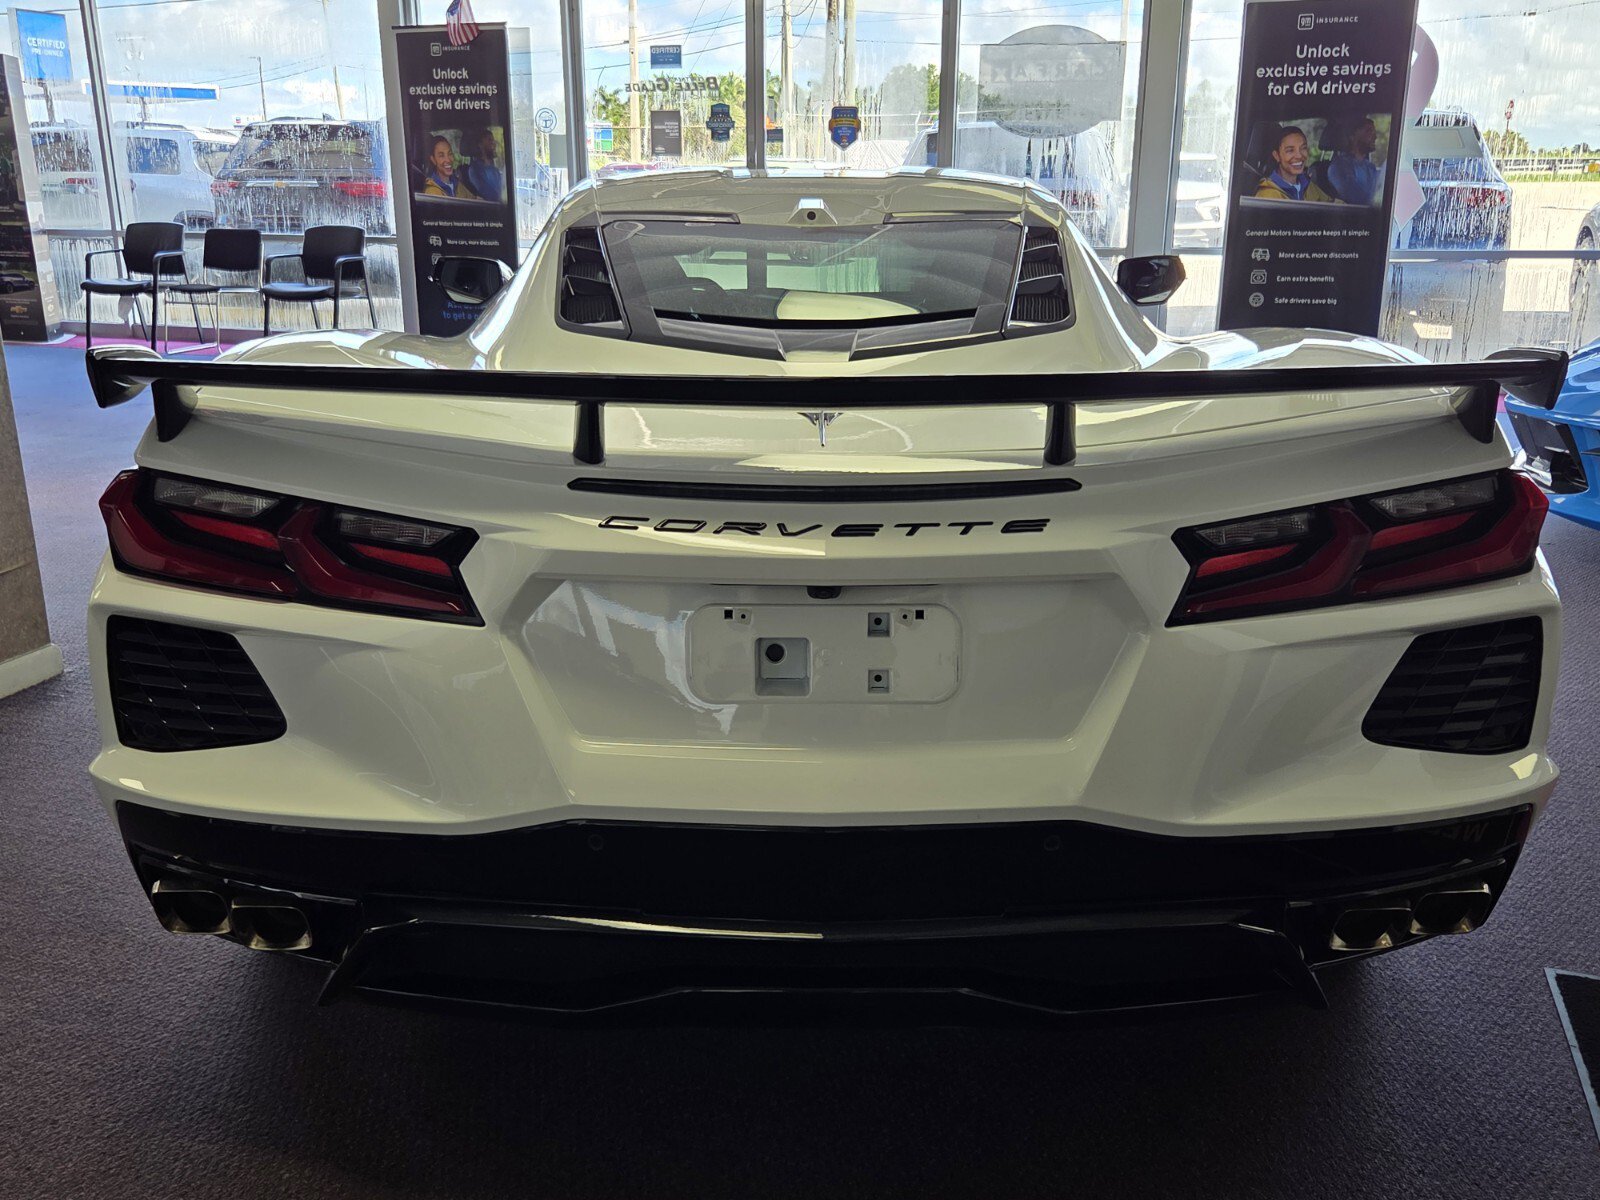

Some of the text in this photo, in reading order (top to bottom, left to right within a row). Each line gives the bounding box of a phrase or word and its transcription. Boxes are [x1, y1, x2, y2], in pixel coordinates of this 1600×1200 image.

[1316, 16, 1359, 24] INSURANCE
[27, 37, 66, 50] CERTIFIED
[1296, 43, 1350, 58] Unlock
[432, 67, 469, 80] Unlock
[1256, 61, 1392, 78] exclusive savings
[409, 82, 498, 97] exclusive savings
[1267, 80, 1376, 96] for GM drivers
[418, 98, 491, 110] for GM drivers
[1245, 229, 1269, 237] General
[1270, 229, 1291, 237] Motors
[1292, 229, 1322, 237] Insurance
[1322, 229, 1341, 238] keeps
[1348, 230, 1370, 238] simple:
[1328, 251, 1359, 259] discounts
[1327, 297, 1337, 306] big
[453, 311, 466, 321] get
[598, 516, 1050, 538] CORVETTE
